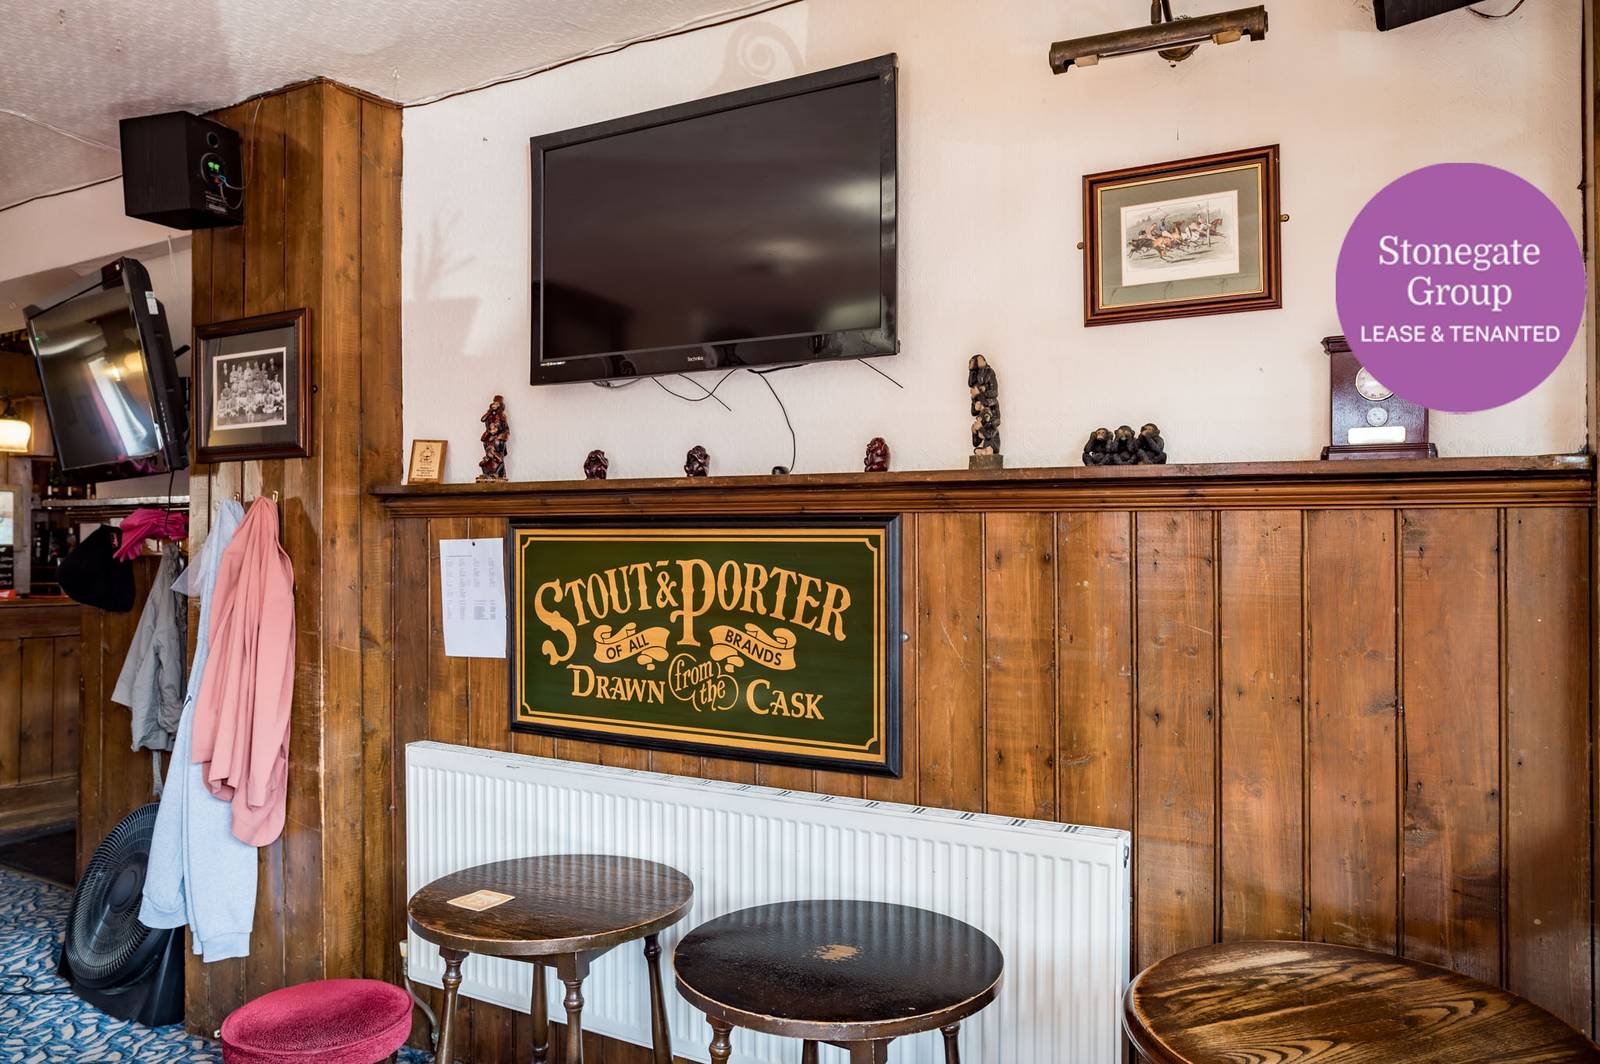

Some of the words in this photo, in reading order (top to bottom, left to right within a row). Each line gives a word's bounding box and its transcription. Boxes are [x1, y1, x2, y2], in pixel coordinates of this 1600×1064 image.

[534, 561, 653, 665] STOUT
[656, 560, 679, 608] &
[669, 559, 852, 648] PORTER
[606, 644, 623, 659] OF
[629, 633, 650, 653] ALL
[724, 629, 783, 667] BRANDS
[566, 663, 665, 705] DRAWN
[673, 658, 713, 692] from
[746, 679, 825, 720] CASK
